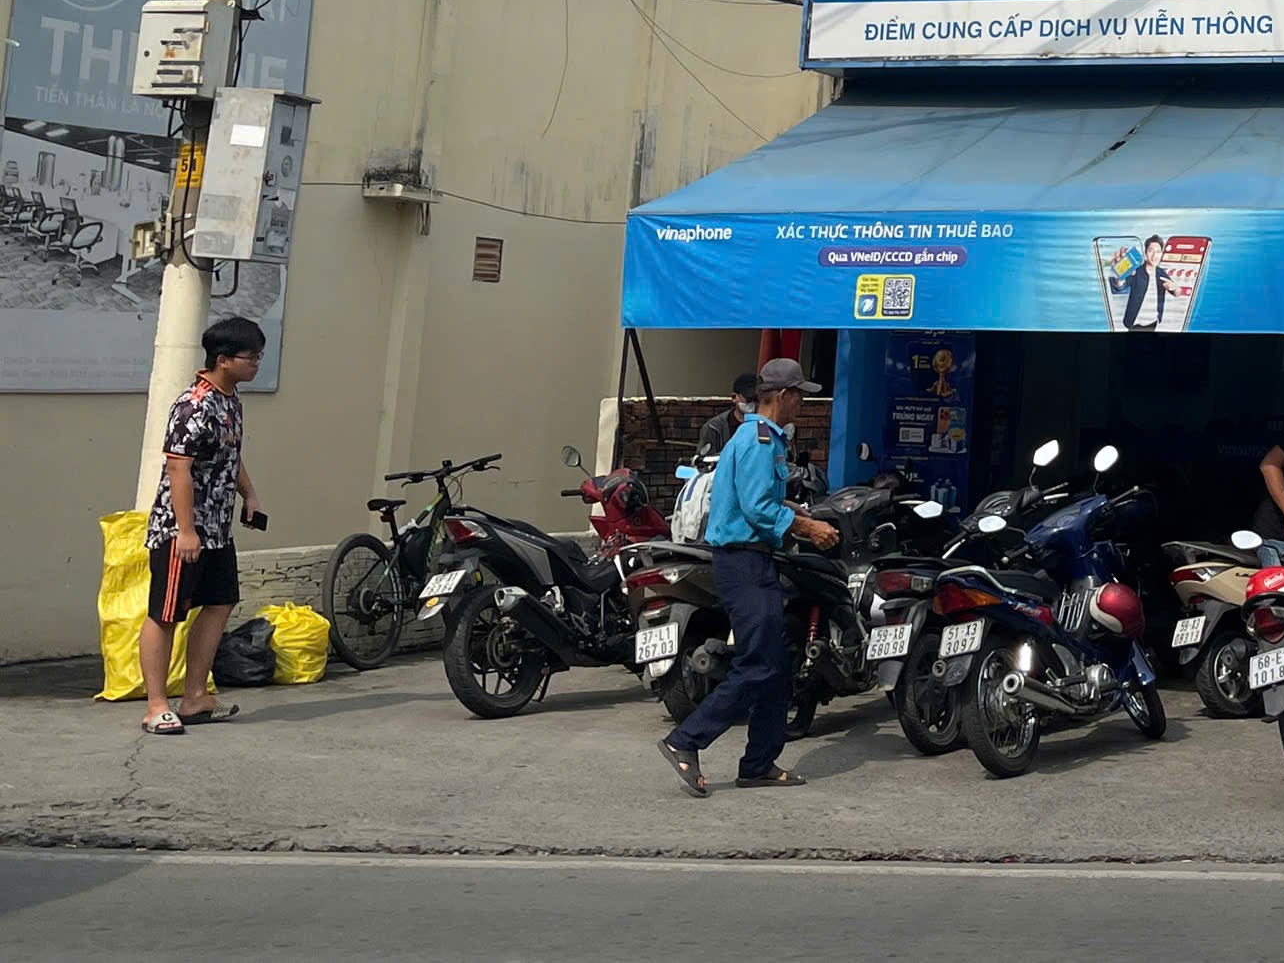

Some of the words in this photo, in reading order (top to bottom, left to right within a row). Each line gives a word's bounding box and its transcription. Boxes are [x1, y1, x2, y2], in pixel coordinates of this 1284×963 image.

[865, 15, 915, 40] ĐIỂM
[922, 21, 982, 38] CUNG
[989, 13, 1033, 37] CẤP
[1039, 19, 1091, 41] DỊCH
[1099, 18, 1128, 40] VỤ
[1135, 9, 1185, 35] VIỄN
[1192, 11, 1273, 34] THÔNG
[41, 16, 139, 85] TH
[656, 225, 732, 243] vinaphone
[776, 222, 805, 239] XÁC
[809, 224, 848, 241] THỰC
[852, 221, 903, 238] THÔNG
[908, 224, 932, 238] TIN
[936, 221, 977, 237] THUÊ
[981, 224, 1013, 237] BAO
[828, 252, 848, 264] Qua
[850, 251, 912, 264] VNeID/CCCD
[914, 248, 934, 264] gắn
[936, 251, 958, 264] chip
[642, 627, 670, 645] 37-L1
[948, 623, 977, 641] 51-X3
[638, 640, 674, 660] 267.03
[946, 637, 975, 655] 3097
